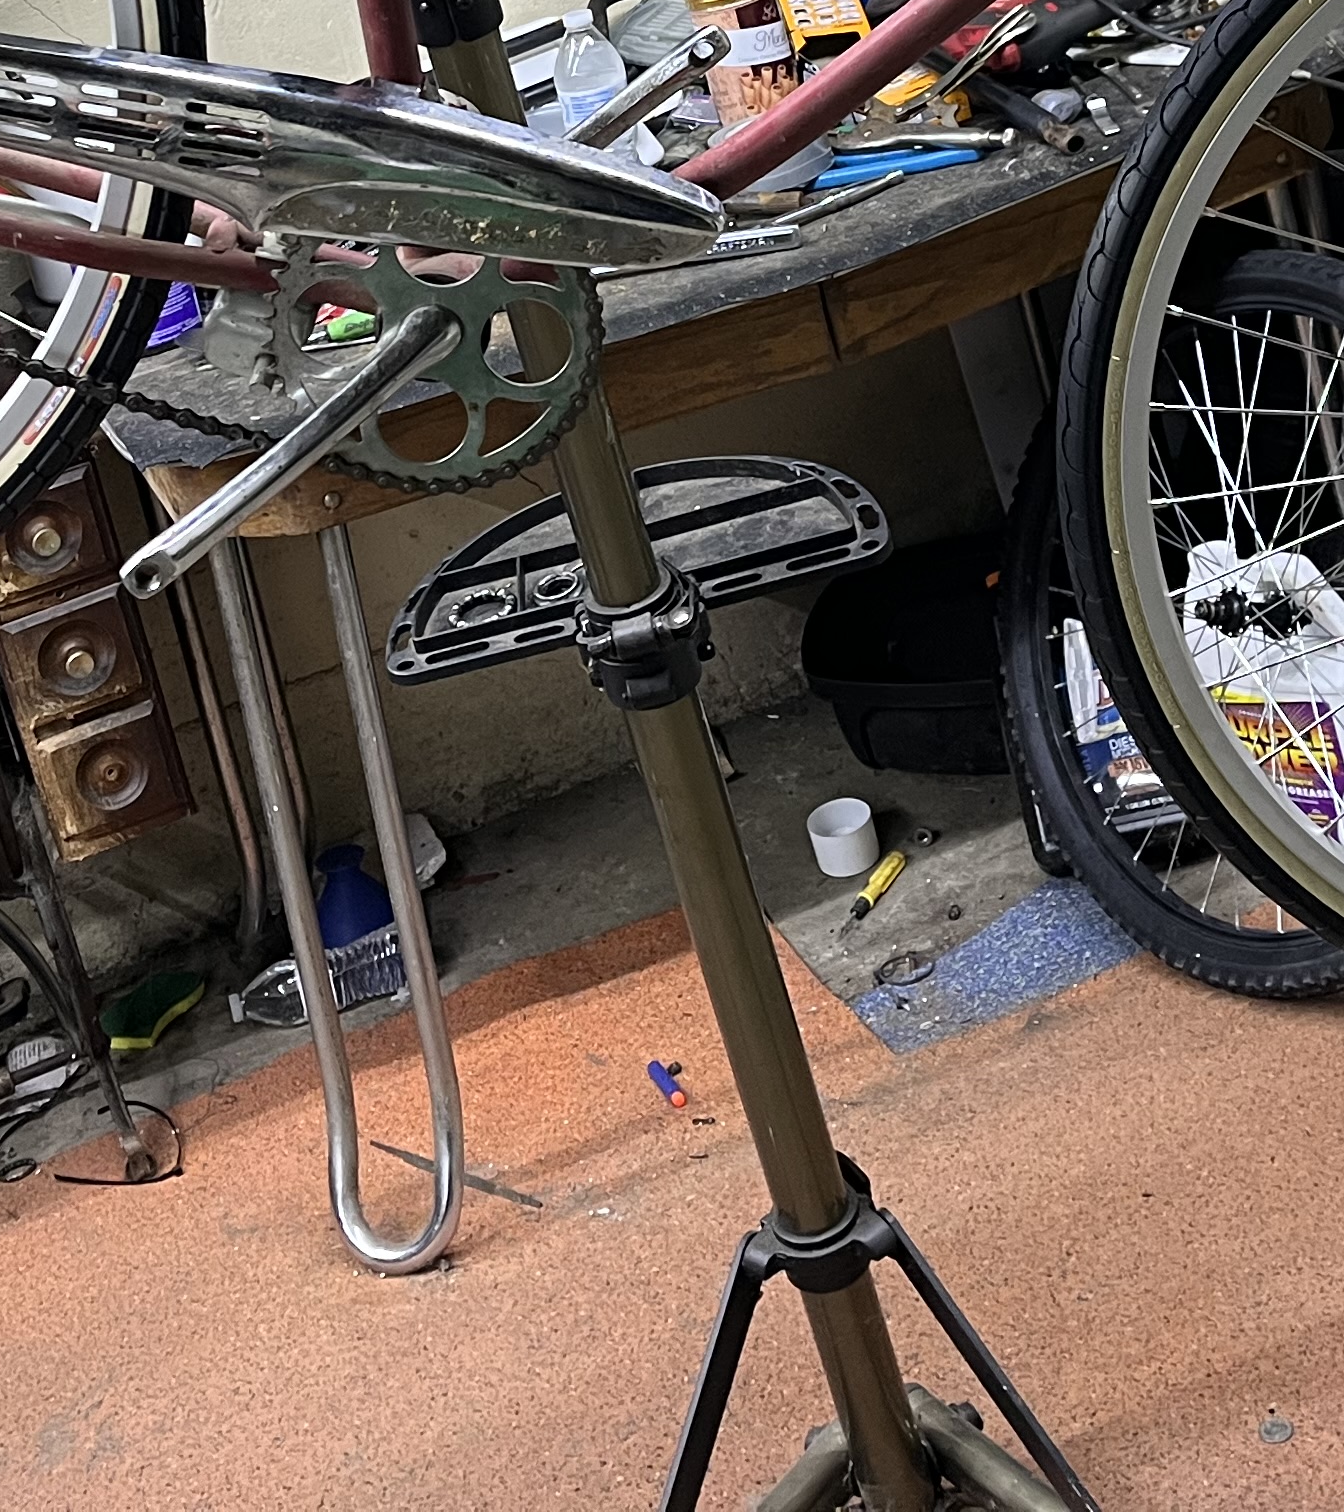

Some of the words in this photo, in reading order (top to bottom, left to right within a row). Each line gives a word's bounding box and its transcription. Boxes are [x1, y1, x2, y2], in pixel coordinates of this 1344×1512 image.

[32, 354, 86, 429] KEST
[1227, 714, 1335, 751] URPLE
[1241, 740, 1339, 777] OWER
